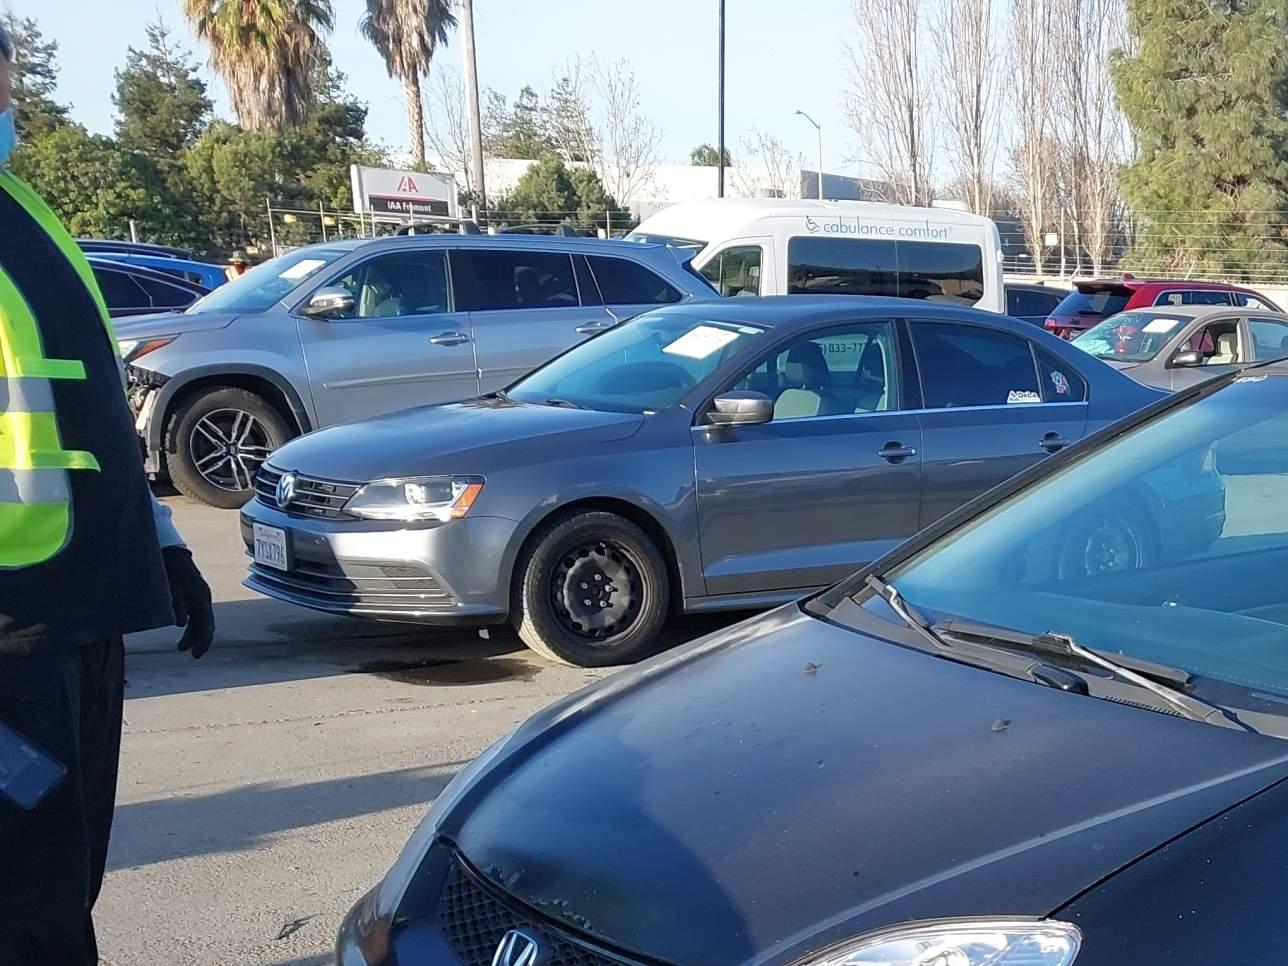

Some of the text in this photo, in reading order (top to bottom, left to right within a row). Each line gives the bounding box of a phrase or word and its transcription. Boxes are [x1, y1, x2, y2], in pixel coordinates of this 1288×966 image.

[402, 201, 432, 212] Frmont
[823, 215, 948, 238] cabulance comfort
